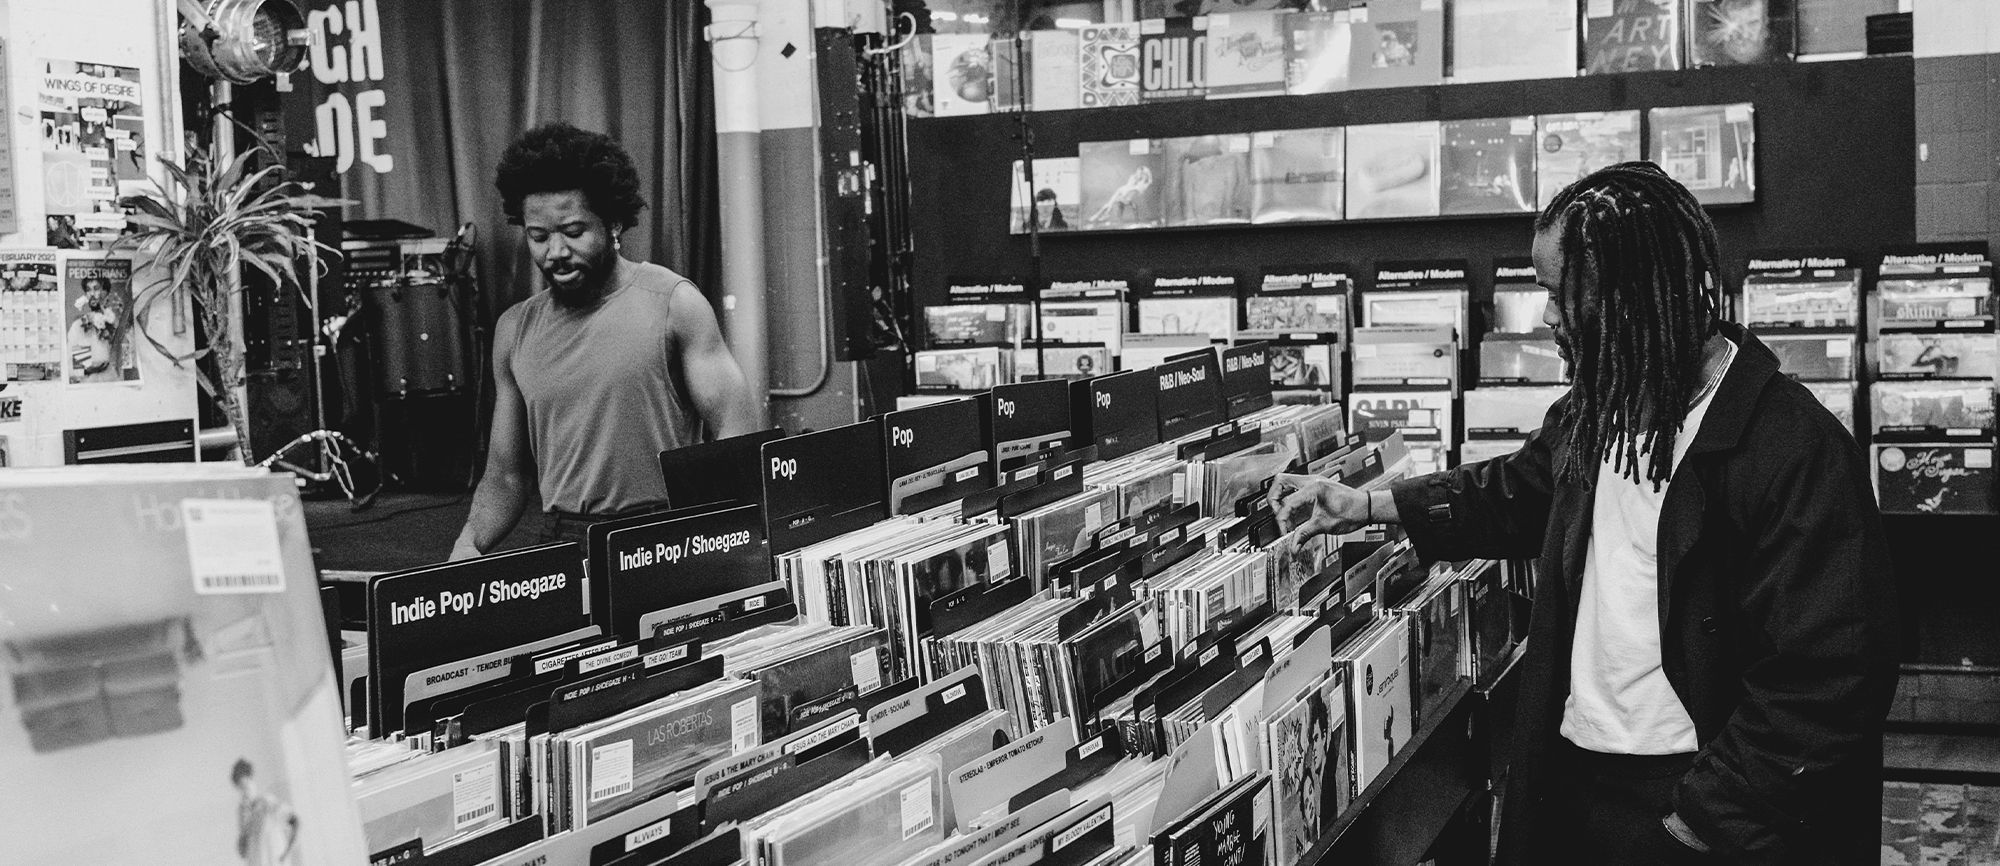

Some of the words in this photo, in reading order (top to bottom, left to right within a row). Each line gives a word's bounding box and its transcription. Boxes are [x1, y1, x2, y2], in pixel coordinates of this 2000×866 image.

[1588, 44, 1669, 74] NEY
[44, 78, 81, 92] WINGS
[84, 81, 98, 93] OF
[100, 83, 135, 97] DESIRE
[1748, 259, 1800, 270] Alternative
[1807, 257, 1846, 268] Modern
[1883, 254, 1936, 265] Alternative
[1944, 252, 1984, 263] Modern
[69, 267, 128, 280] PEDESTRIANS
[1154, 277, 1198, 287] Alternative
[1202, 276, 1234, 286] Modern
[1264, 274, 1307, 284] Alternative
[1314, 272, 1346, 282] Modern
[1378, 270, 1424, 281] Alternative
[1430, 270, 1464, 280] Modern
[1226, 357, 1238, 372] R&B
[1242, 352, 1265, 369] Neo-Soul
[1160, 373, 1174, 391] R&B
[1178, 365, 1206, 386] Neo-Soul
[998, 398, 1014, 418] Pop
[1096, 391, 1111, 409] Pop
[892, 426, 914, 448] Pop
[771, 456, 797, 480] Pop
[620, 547, 652, 571] Indie
[656, 542, 681, 564] Pop
[684, 537, 690, 558] /
[692, 529, 750, 556] Shoegaze
[391, 597, 436, 626] Indie
[440, 591, 474, 614] Pop
[478, 582, 486, 608] /
[489, 572, 566, 604] Shoegaze
[676, 624, 684, 633] POP
[688, 618, 710, 629] SHOEGAZE
[585, 661, 594, 669] THE
[597, 656, 611, 666] DIVINE
[612, 650, 632, 661] COMEDY
[648, 656, 658, 664] THE
[668, 650, 682, 659] TEAM
[426, 668, 468, 686] BROADCAST
[476, 659, 502, 673] TENDER
[564, 690, 578, 701] INDIE
[578, 688, 590, 697] POP
[595, 678, 622, 691] SHOEGAZE
[890, 698, 910, 714] SOUVLAKI
[648, 725, 666, 746] LAS
[666, 709, 714, 738] ROBERTAS
[808, 736, 818, 747] AND
[818, 730, 828, 742] THE
[828, 724, 841, 738] MARY
[842, 719, 855, 732] CHAIN
[704, 772, 720, 786] JESUS
[721, 769, 725, 777] &
[727, 764, 738, 774] THE
[740, 756, 756, 770] MARY
[757, 750, 774, 763] CHAIN
[959, 764, 984, 783] STEREOLAB
[986, 753, 1008, 770] EMPEROR
[1008, 745, 1026, 760] TOMATO
[1026, 736, 1044, 752] KETCHUP
[1058, 836, 1065, 847] MY
[1065, 828, 1082, 842] BLOODY
[1083, 812, 1106, 832] VALENTINE
[1212, 810, 1235, 840] YOUNG
[944, 854, 952, 864] SO
[953, 840, 977, 860] TONIGHT
[977, 833, 991, 847] THAT
[995, 824, 1010, 838] MIGHT
[1010, 817, 1020, 830] SEE
[1217, 830, 1241, 856] MARBLE
[403, 850, 410, 859] G
